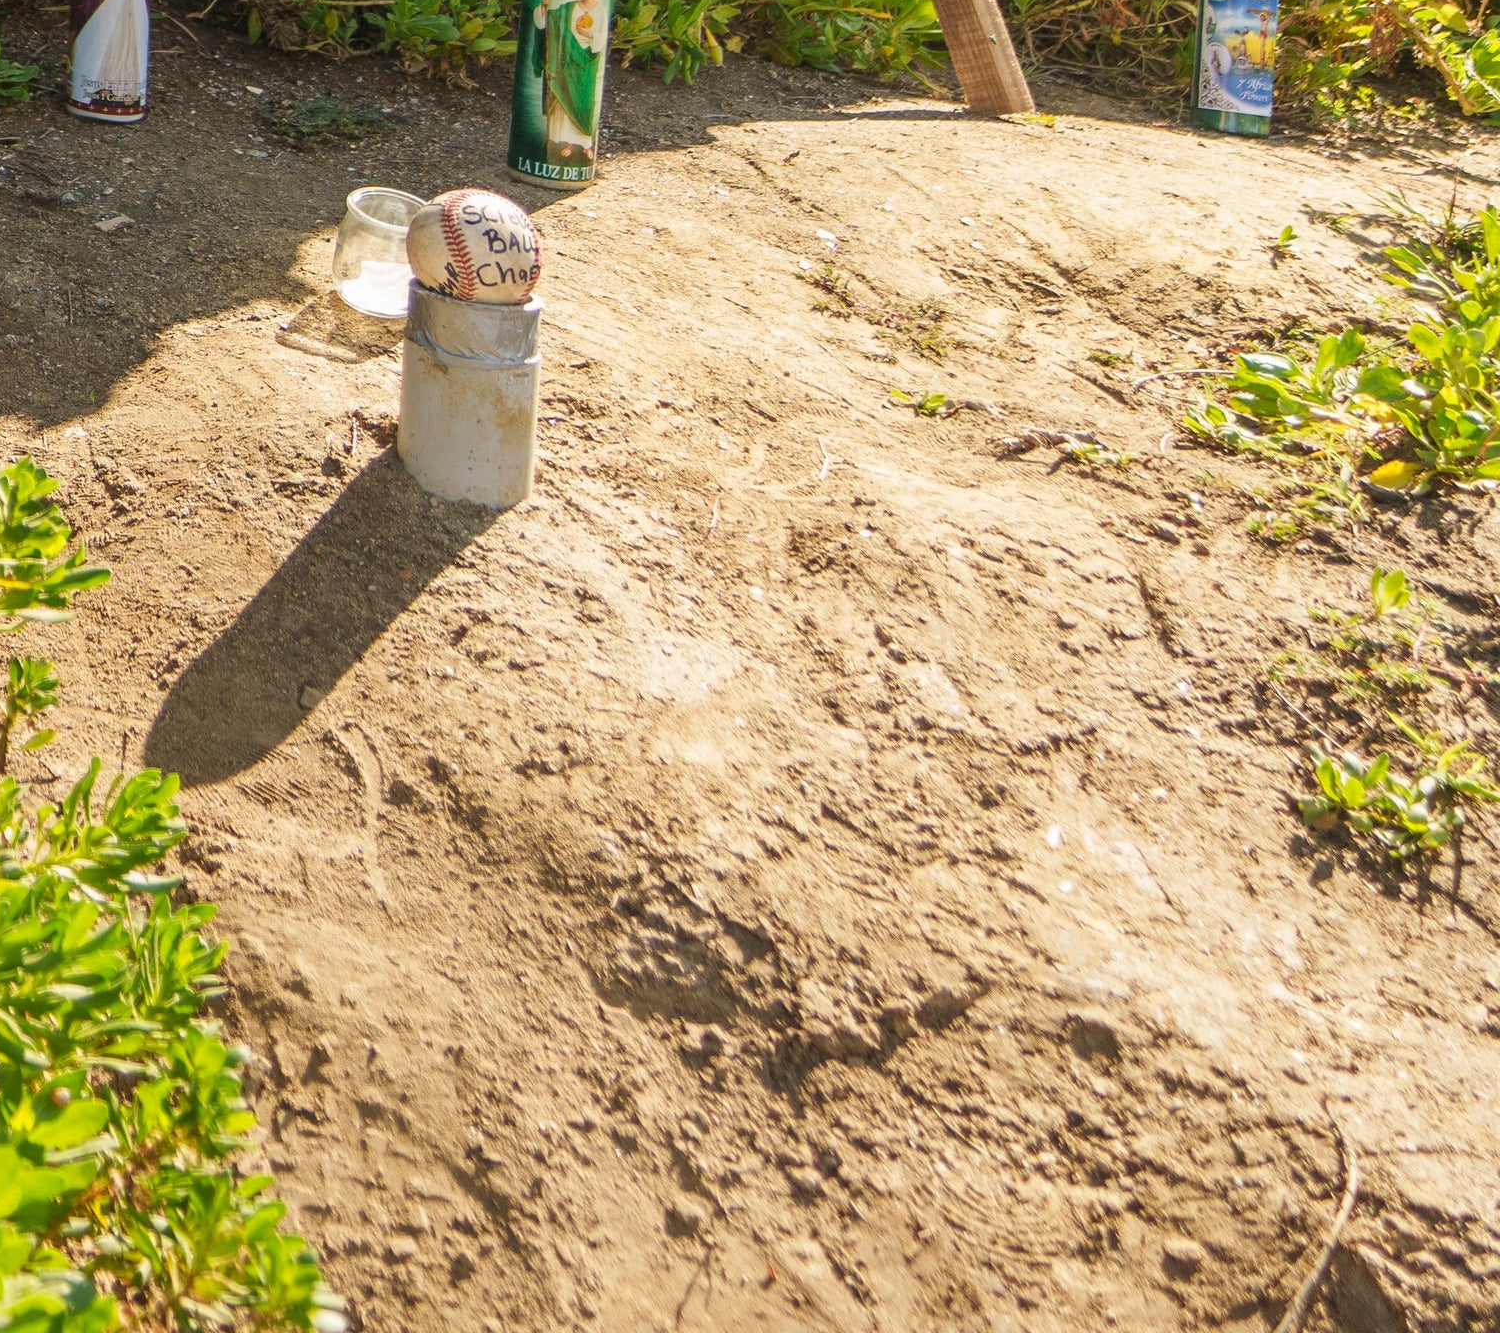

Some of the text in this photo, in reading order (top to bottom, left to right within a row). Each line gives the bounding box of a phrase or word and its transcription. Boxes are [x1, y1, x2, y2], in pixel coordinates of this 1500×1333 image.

[518, 156, 532, 174] LA
[534, 161, 560, 180] LUZ
[562, 165, 579, 181] DE
